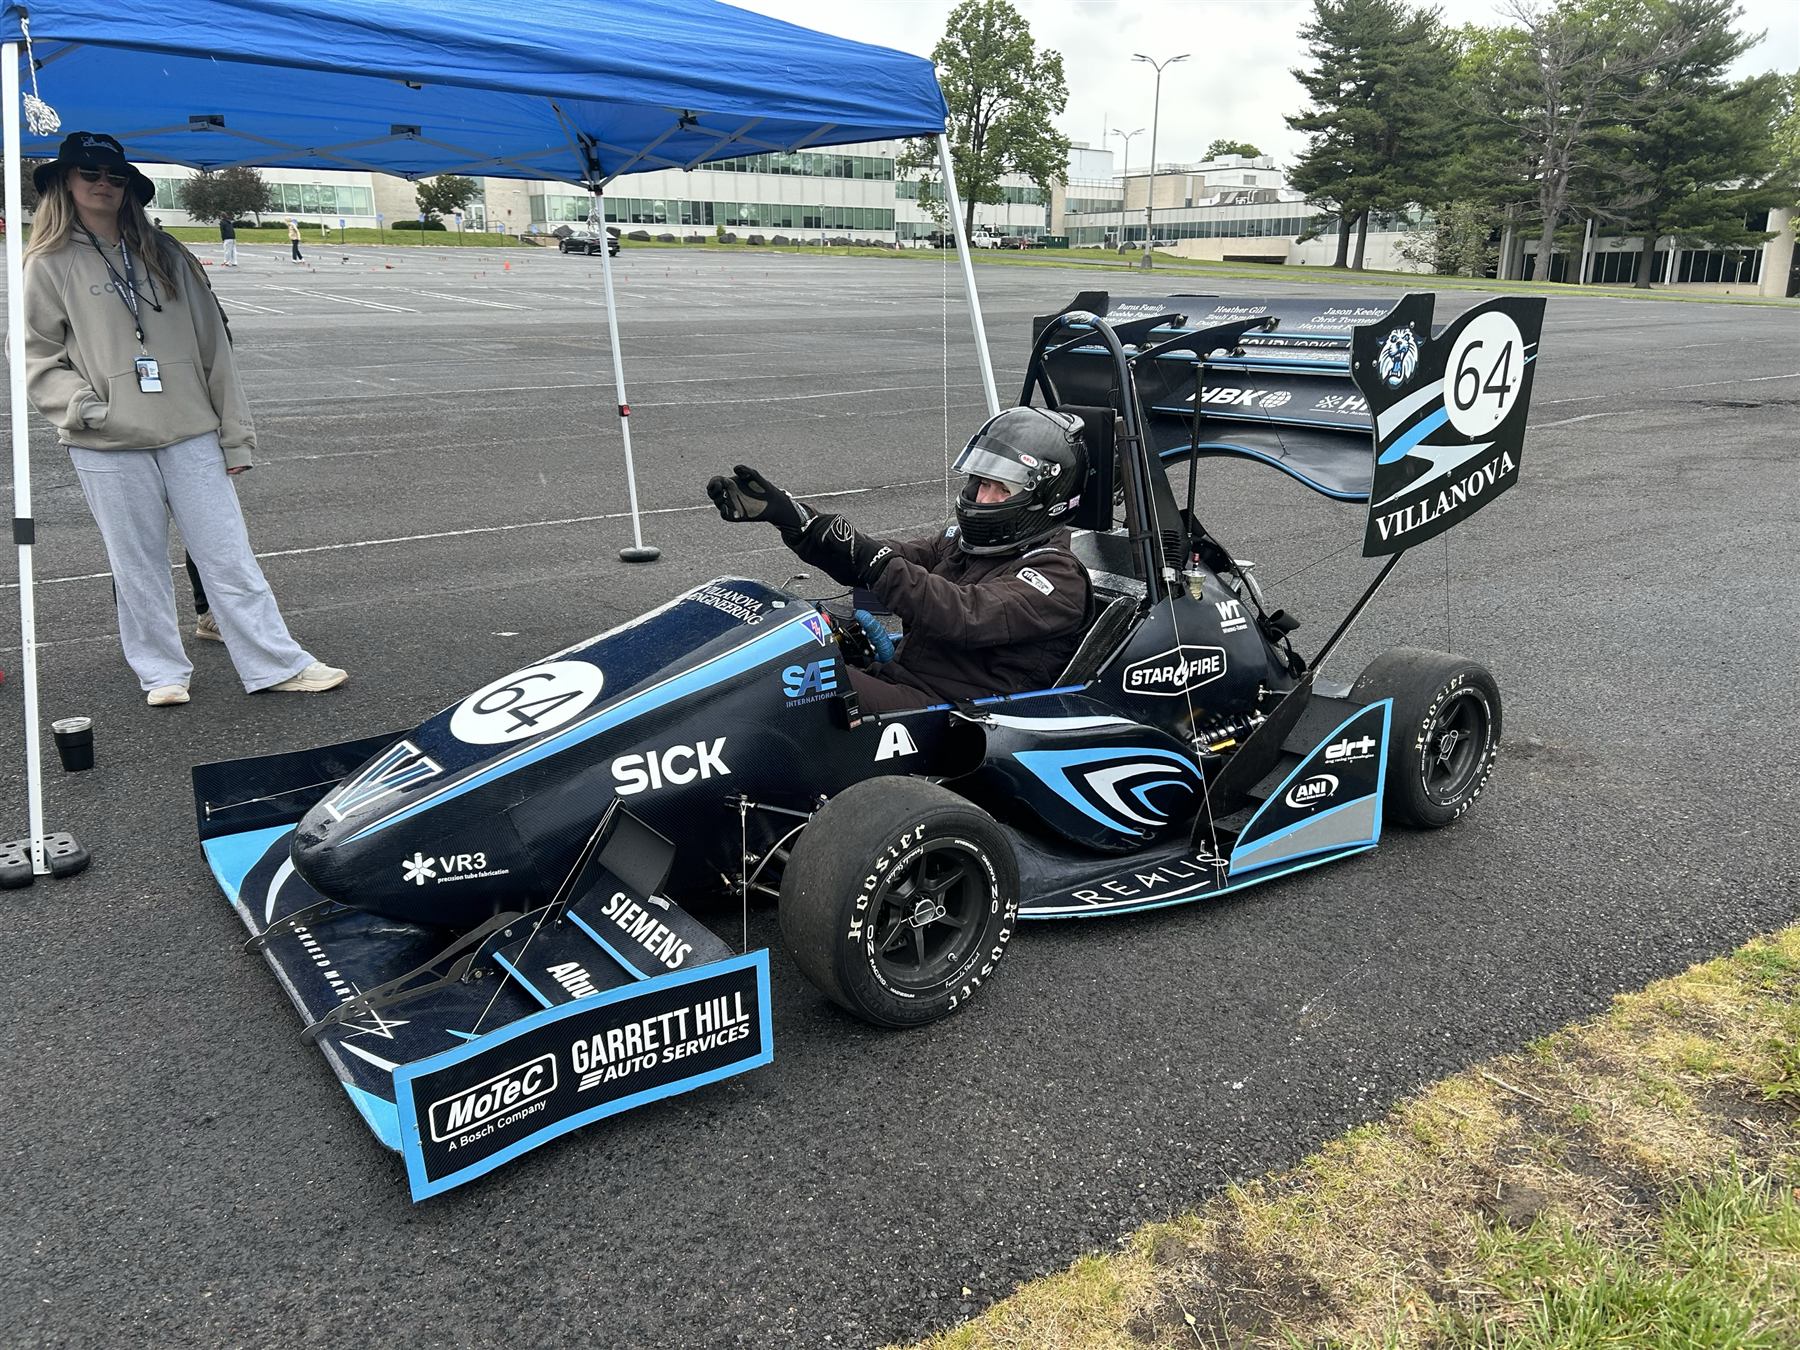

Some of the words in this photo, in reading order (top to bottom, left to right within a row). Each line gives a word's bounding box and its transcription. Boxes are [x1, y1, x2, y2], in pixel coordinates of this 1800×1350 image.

[1140, 304, 1166, 312] Family
[1214, 306, 1247, 314] Heather
[1248, 306, 1267, 314] Gill
[1353, 308, 1387, 317] Keeley
[1185, 386, 1268, 406] HBK
[1453, 340, 1513, 412] 64
[1375, 450, 1515, 541] VILLANOVA
[687, 592, 764, 626] ENGINEERING
[702, 585, 764, 612] VILLANOVA
[1214, 599, 1240, 620] WT
[782, 658, 838, 698] SAE
[1131, 666, 1174, 686] STAR
[1189, 655, 1220, 678] FIRE
[472, 672, 584, 734] 64
[785, 690, 838, 708] INTERNATIONAL
[1415, 673, 1465, 752] Hoosier
[322, 739, 444, 823] V
[611, 736, 732, 796] SICK
[1296, 780, 1327, 798] ANI
[437, 875, 464, 884] precision
[478, 868, 510, 878] fabrication
[440, 852, 487, 873] VR3
[847, 823, 926, 943] Hoosier
[289, 921, 331, 967] CKHEED
[600, 892, 692, 969] SIEMENS
[866, 924, 875, 956] OZ
[948, 898, 1019, 1010] Hoosier
[571, 1007, 690, 1074] GARRETT
[695, 991, 750, 1035] HILL
[603, 1052, 658, 1084] AUTO
[662, 1022, 750, 1064] SERVICES
[446, 1064, 544, 1132] MoTeC
[448, 1141, 457, 1152] A
[460, 1124, 494, 1147] Bosch
[497, 1100, 546, 1128] Company
